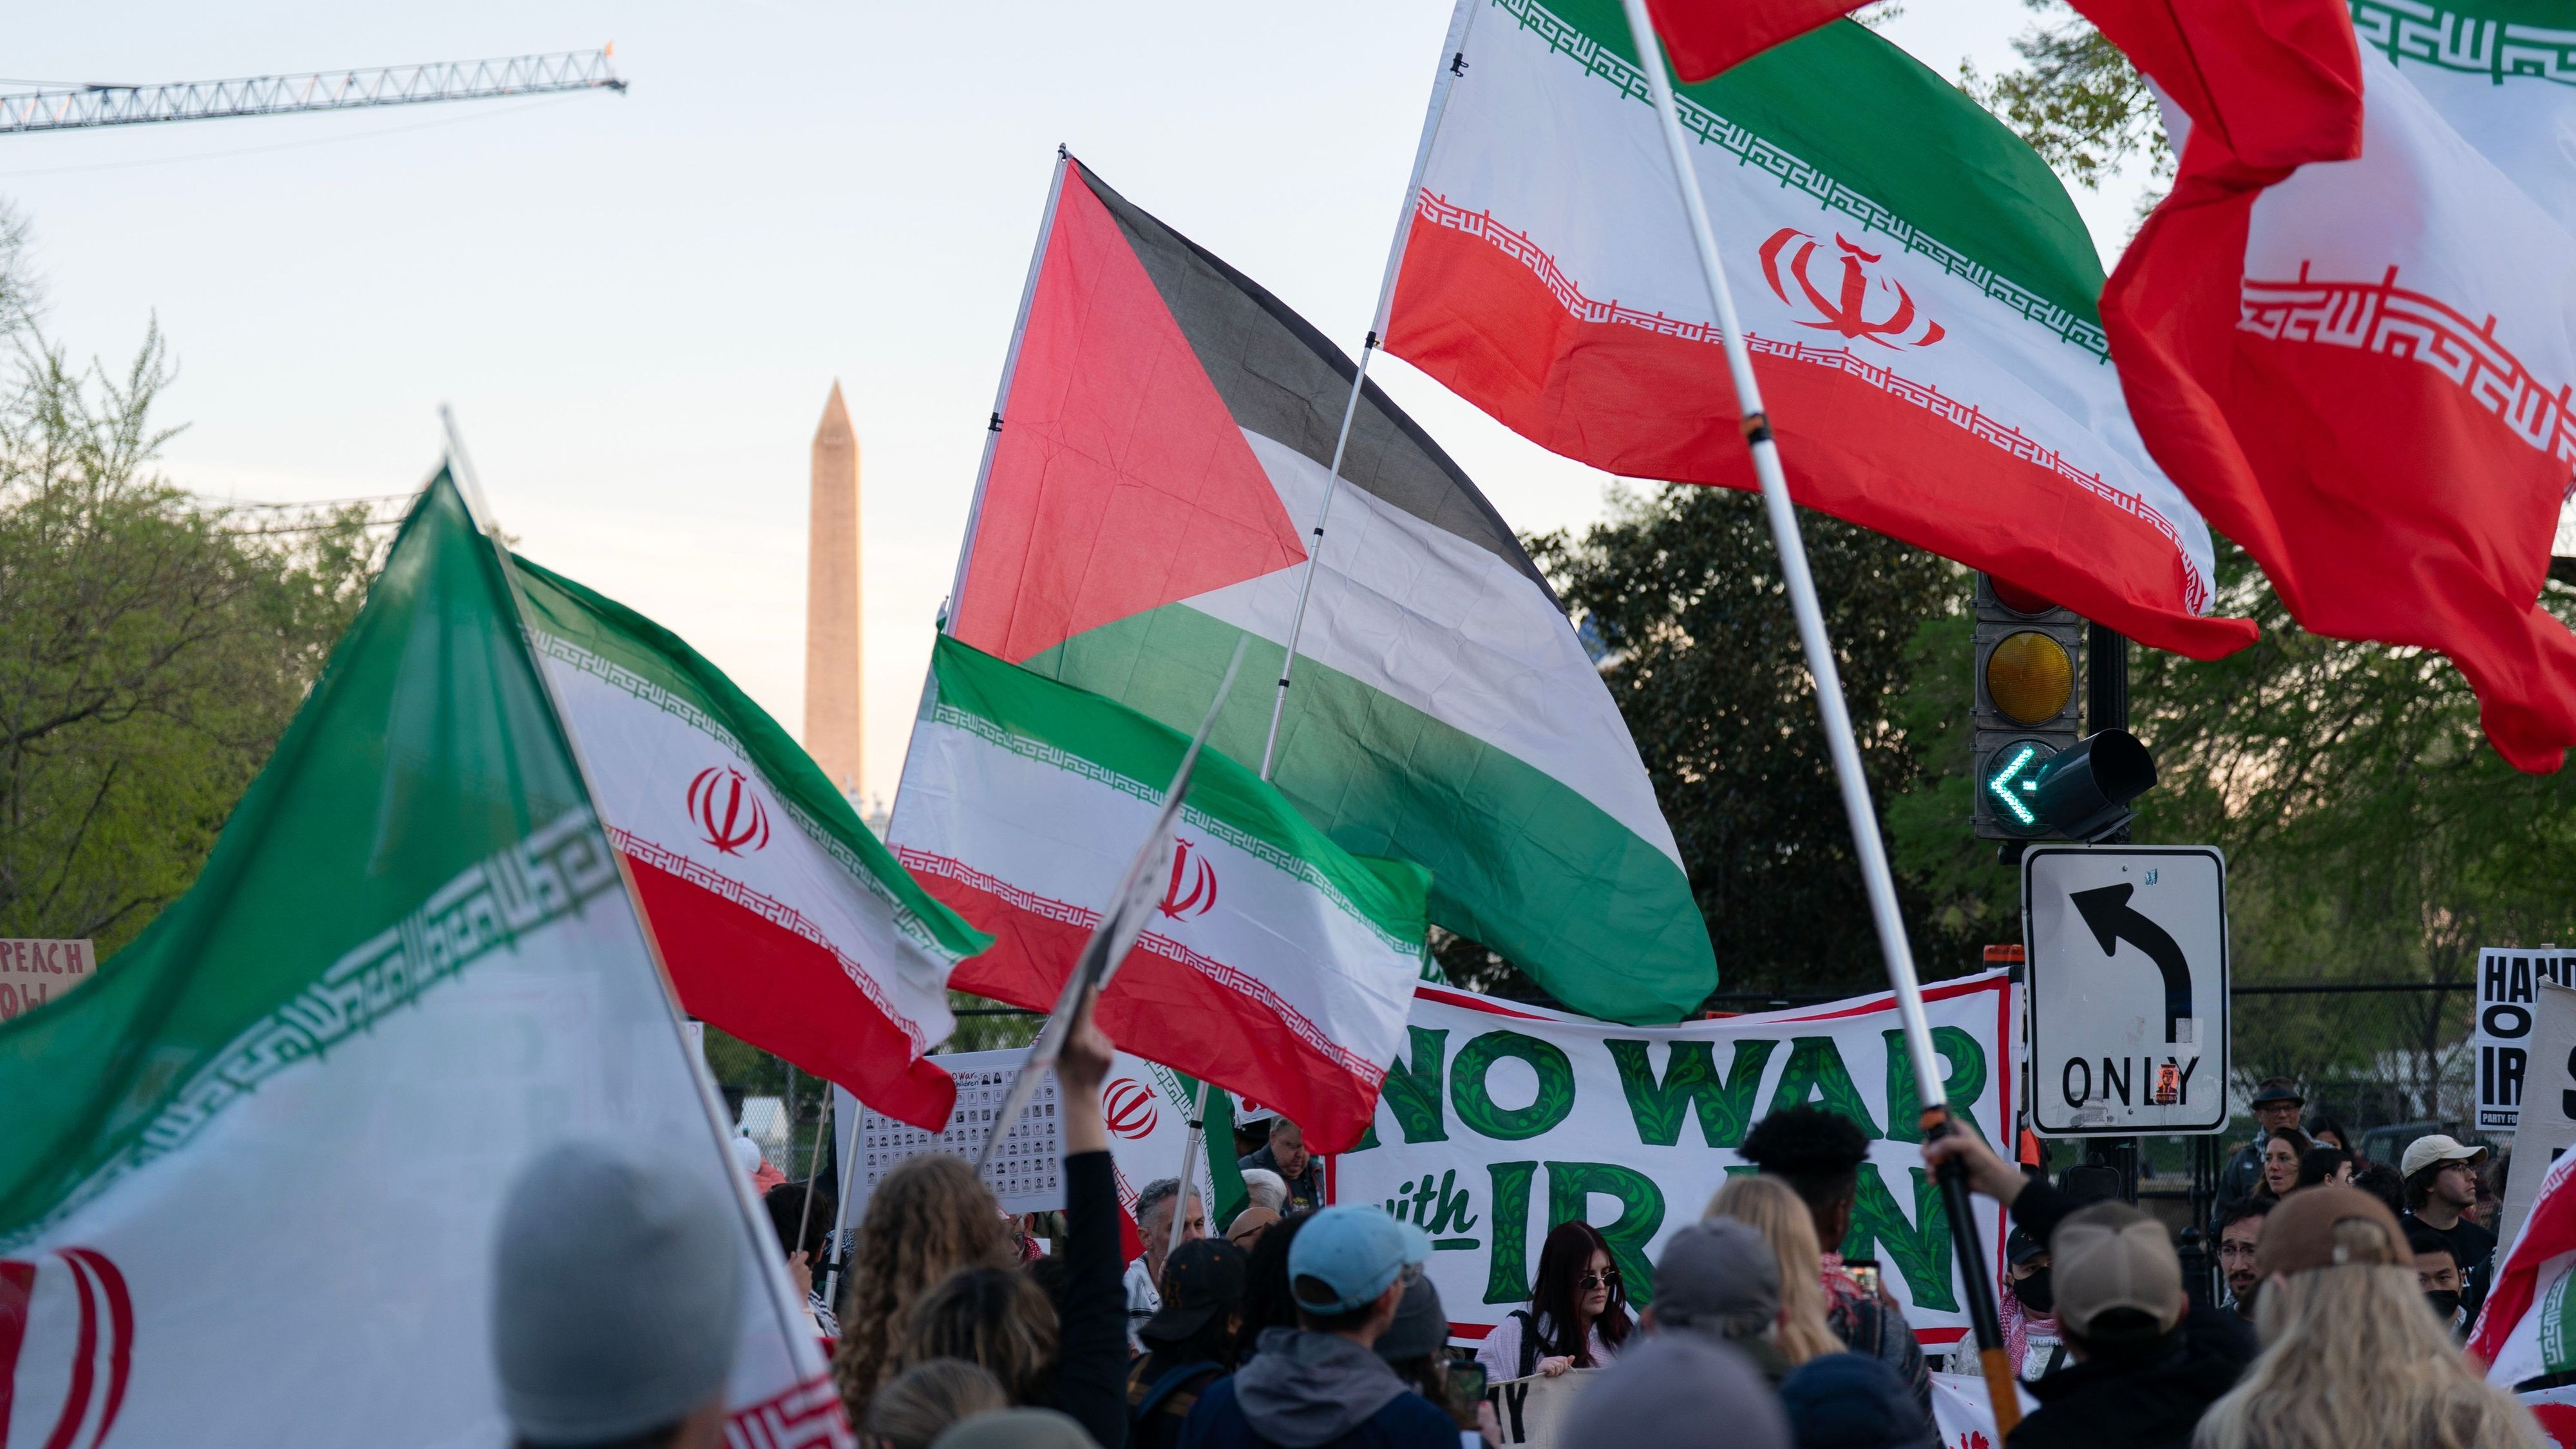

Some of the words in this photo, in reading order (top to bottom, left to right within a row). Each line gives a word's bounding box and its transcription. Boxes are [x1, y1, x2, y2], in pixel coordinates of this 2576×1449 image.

[0, 942, 83, 974] PEACH
[959, 1072, 976, 1081] War
[1345, 1025, 1577, 1154] NO
[1603, 1025, 1996, 1153] WAR
[2062, 1056, 2201, 1108] ONLY
[2483, 1113, 2505, 1123] PARTY
[1372, 1169, 1479, 1235] ith
[1482, 1160, 1961, 1313] IRN
